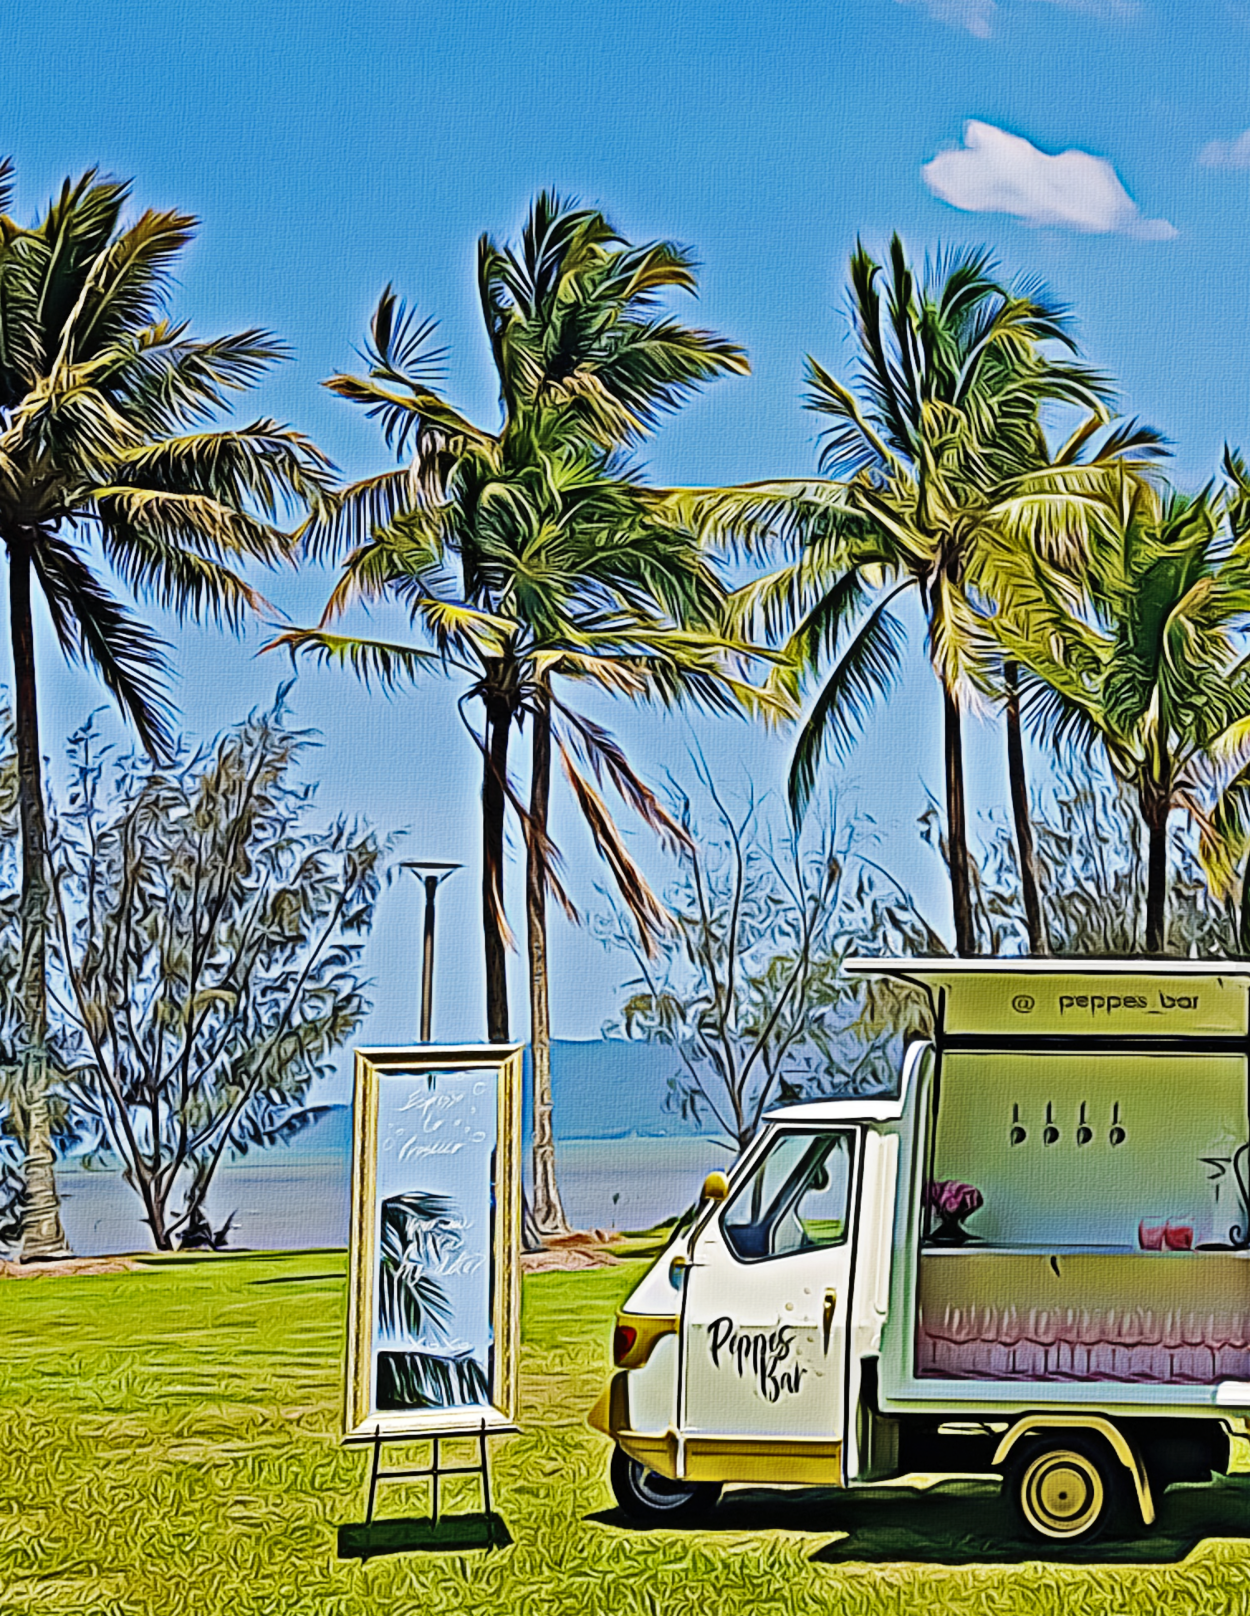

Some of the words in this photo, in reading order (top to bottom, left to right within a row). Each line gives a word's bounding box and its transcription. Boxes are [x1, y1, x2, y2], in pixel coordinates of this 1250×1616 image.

[1012, 994, 1035, 1013] @
[1058, 989, 1199, 1017] peppes_bar
[759, 1352, 808, 1403] Bar
